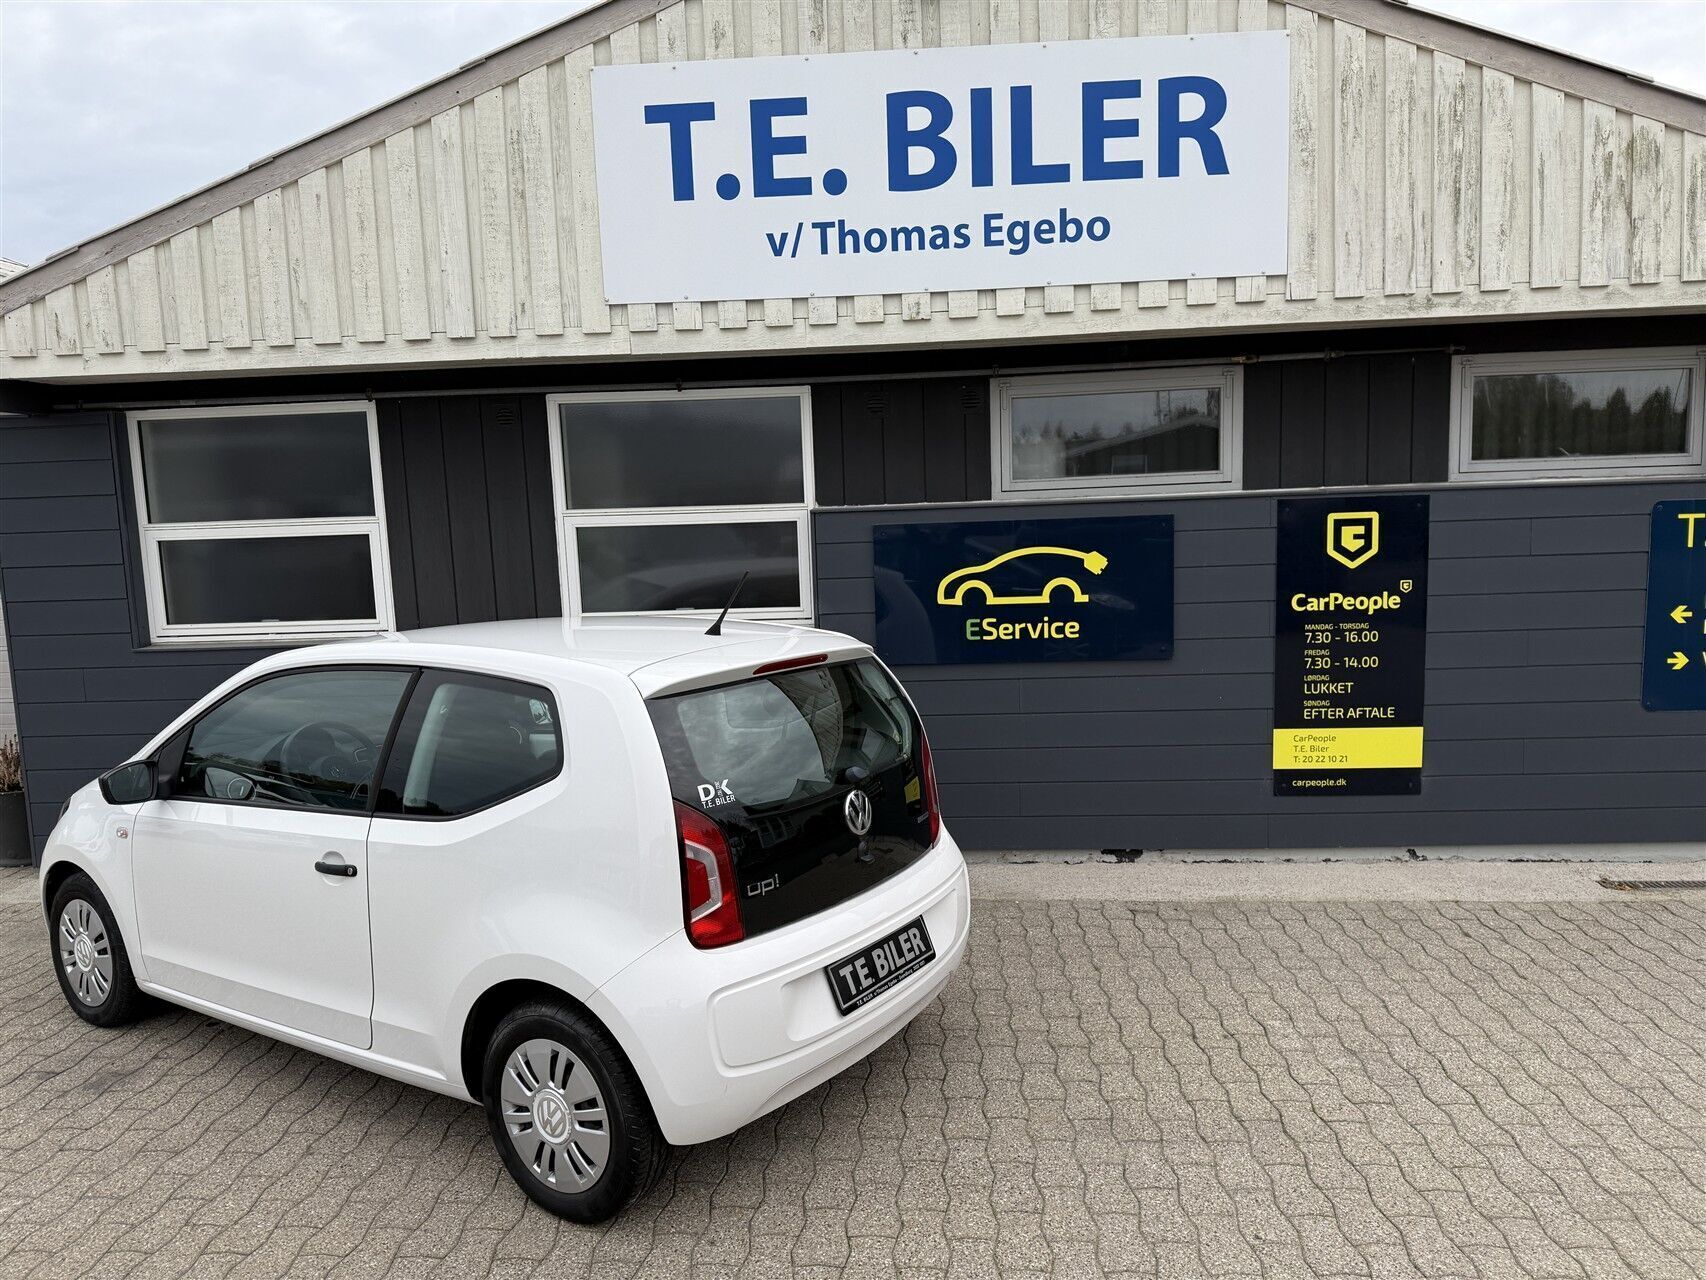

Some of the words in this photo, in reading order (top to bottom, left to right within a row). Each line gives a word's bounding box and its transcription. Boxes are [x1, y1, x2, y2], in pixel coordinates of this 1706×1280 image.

[644, 96, 847, 201] T.E.
[886, 75, 1230, 192] BILER
[766, 221, 803, 258] v/
[812, 218, 970, 255] Thomas
[983, 208, 1111, 255] Egebo
[1291, 591, 1401, 615] CarPeople
[966, 616, 1080, 640] EService
[1339, 622, 1370, 630] TORSDAG
[1304, 632, 1331, 644] 7.30
[1344, 631, 1379, 643] 16.00
[1304, 657, 1331, 669] 7.30
[1343, 656, 1379, 668] 14.00
[1304, 683, 1354, 694] LUKKET
[1303, 708, 1344, 720] EFTER
[1346, 707, 1396, 719] AFTALE
[1293, 734, 1337, 744] CarPeople
[1309, 745, 1330, 753] Biler
[1315, 755, 1326, 763] 22
[1327, 755, 1337, 763] 10
[1292, 778, 1347, 787] carpeople.dk
[702, 800, 716, 809] T.E.
[715, 795, 736, 806] BILER
[747, 874, 779, 896] up!
[839, 957, 876, 996] T.E.
[871, 928, 926, 978] BILER
